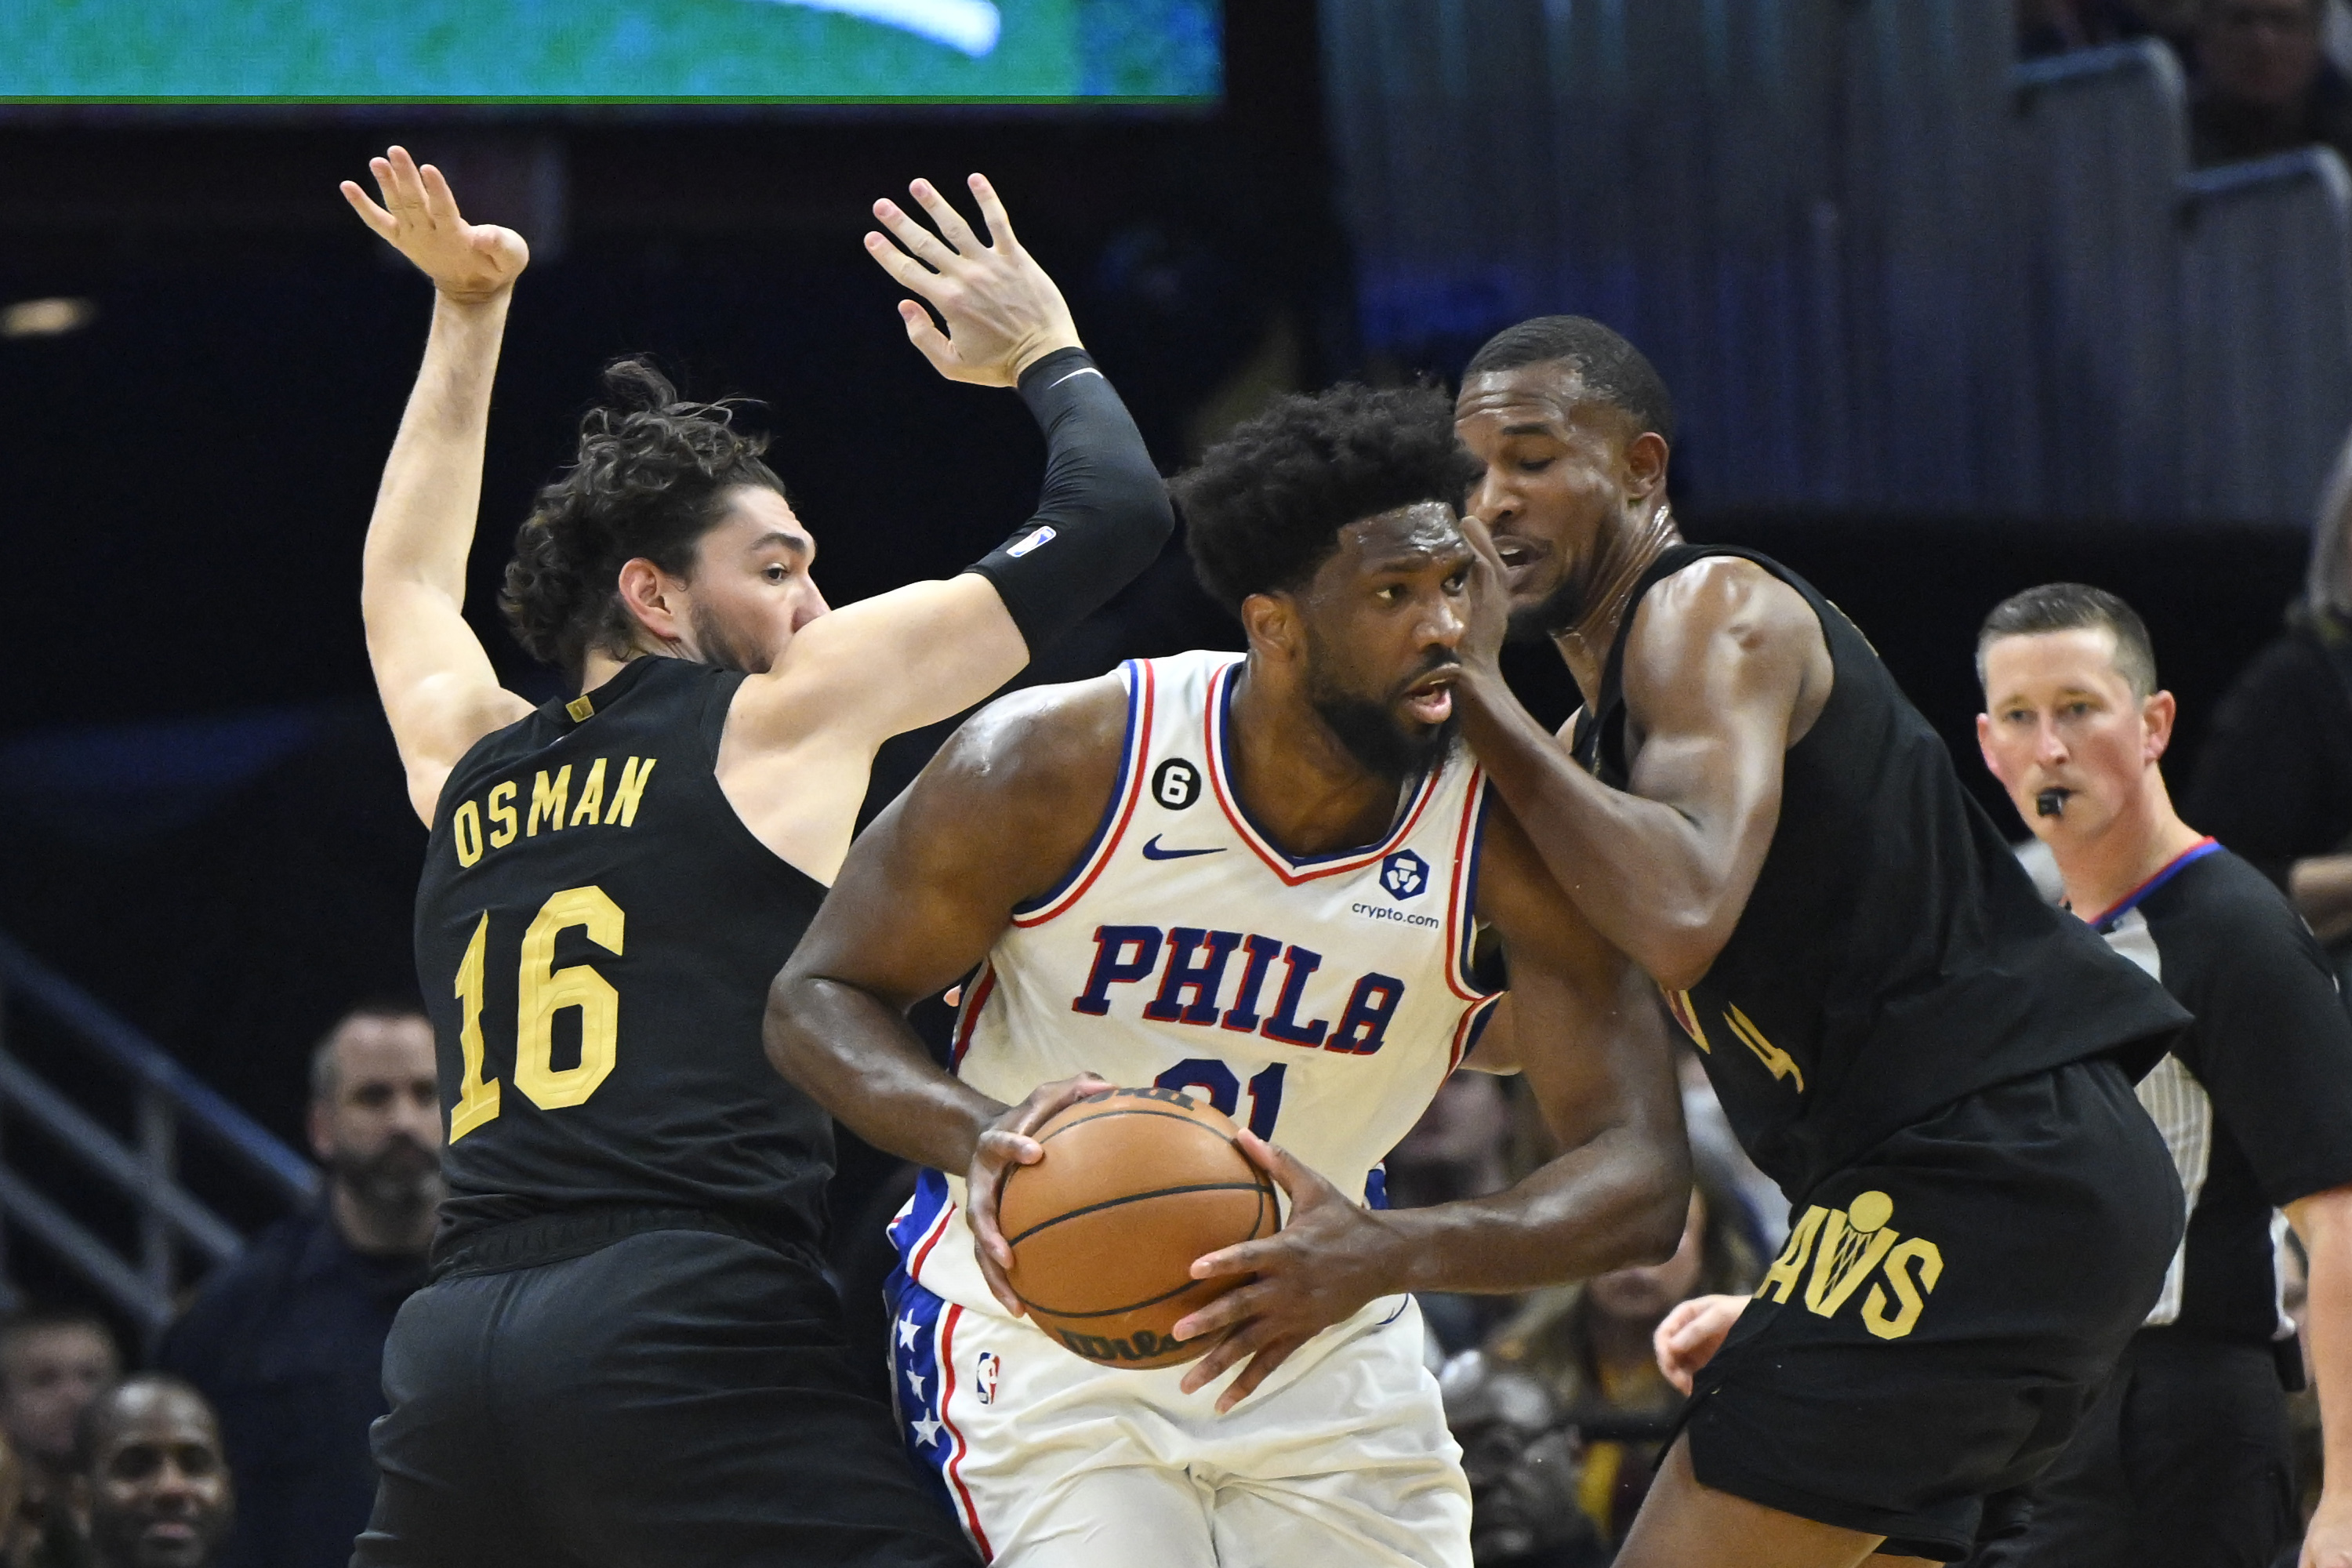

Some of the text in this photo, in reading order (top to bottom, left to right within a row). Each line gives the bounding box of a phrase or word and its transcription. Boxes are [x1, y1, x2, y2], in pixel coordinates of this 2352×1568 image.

[454, 756, 657, 868] OSMAN
[1161, 765, 1191, 804] 6
[1352, 902, 1439, 929] crypto.com
[449, 885, 625, 1145] 16
[1071, 925, 1405, 1055] PHILA
[1755, 1190, 1944, 1341] AVS
